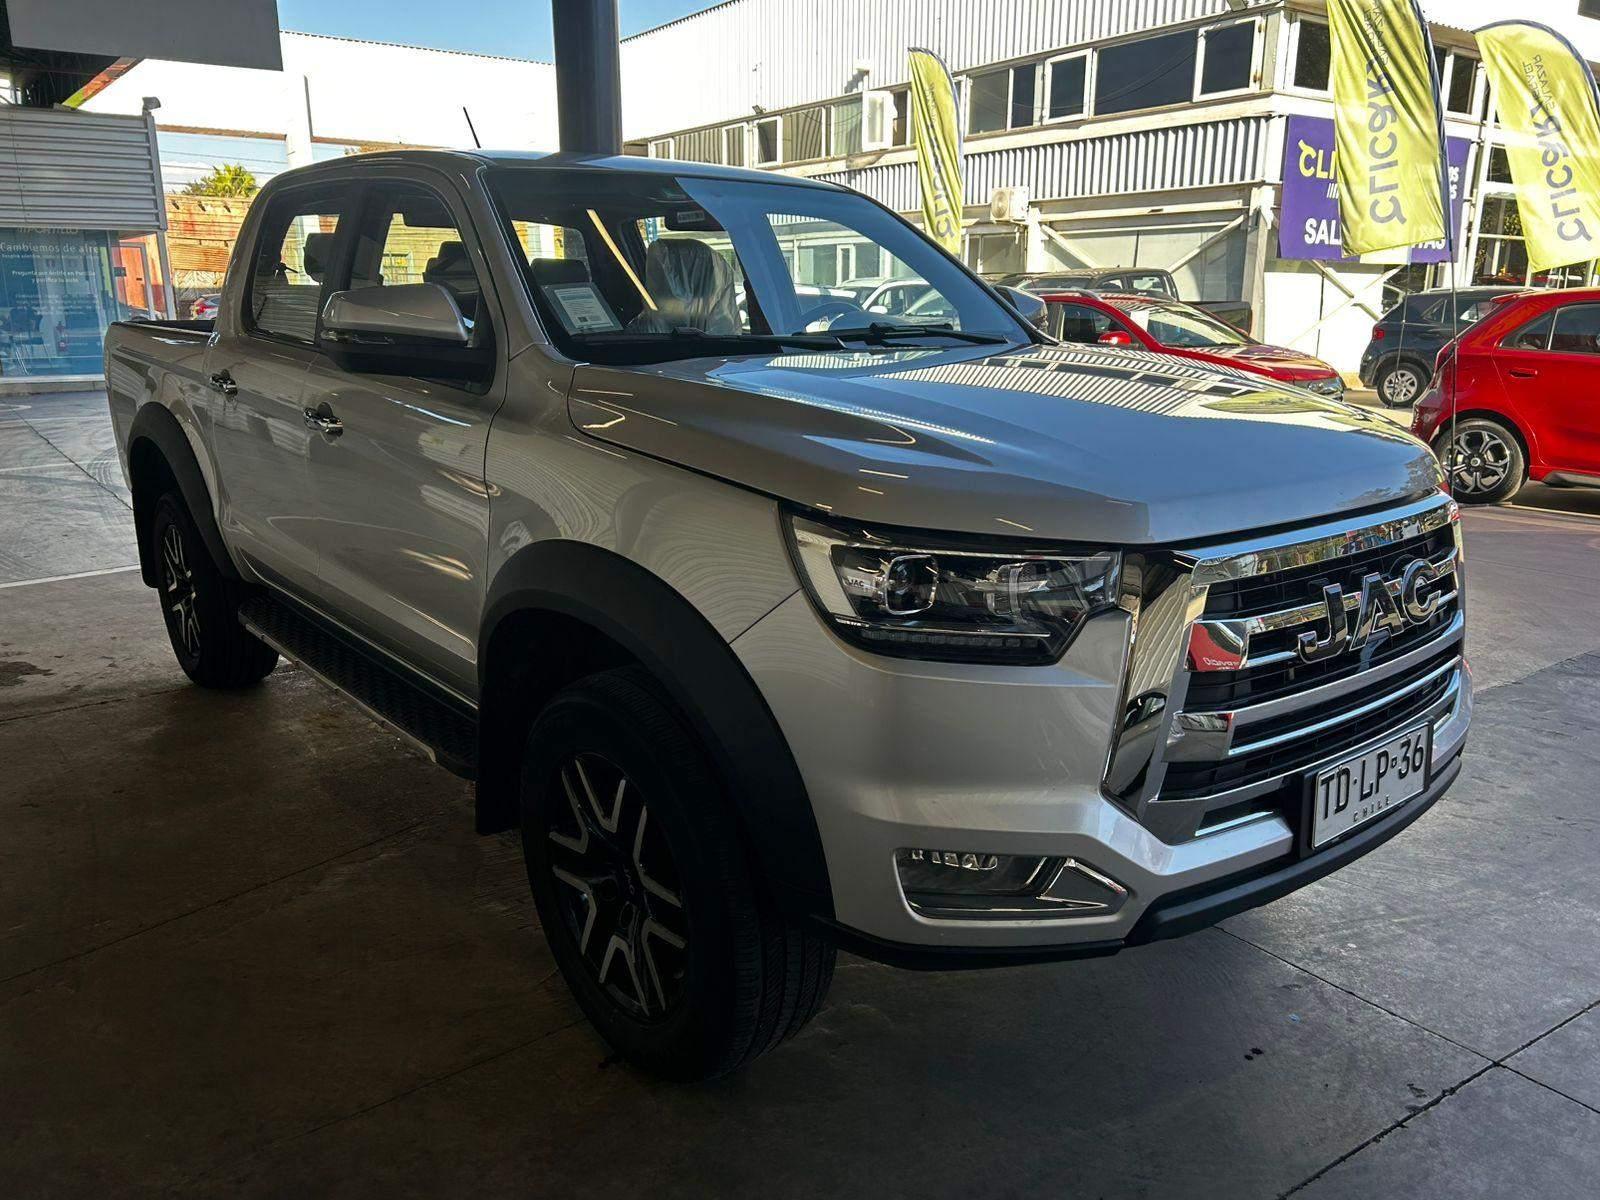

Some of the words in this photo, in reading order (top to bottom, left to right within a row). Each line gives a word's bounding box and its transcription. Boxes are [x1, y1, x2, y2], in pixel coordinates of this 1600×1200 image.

[1298, 139, 1337, 180] CLI
[1304, 217, 1342, 245] SAL
[0, 241, 60, 253] Cambiemos
[63, 242, 76, 253] de
[848, 579, 865, 588] JAC
[1297, 558, 1441, 664] JAC
[1353, 795, 1390, 822] CHILE
